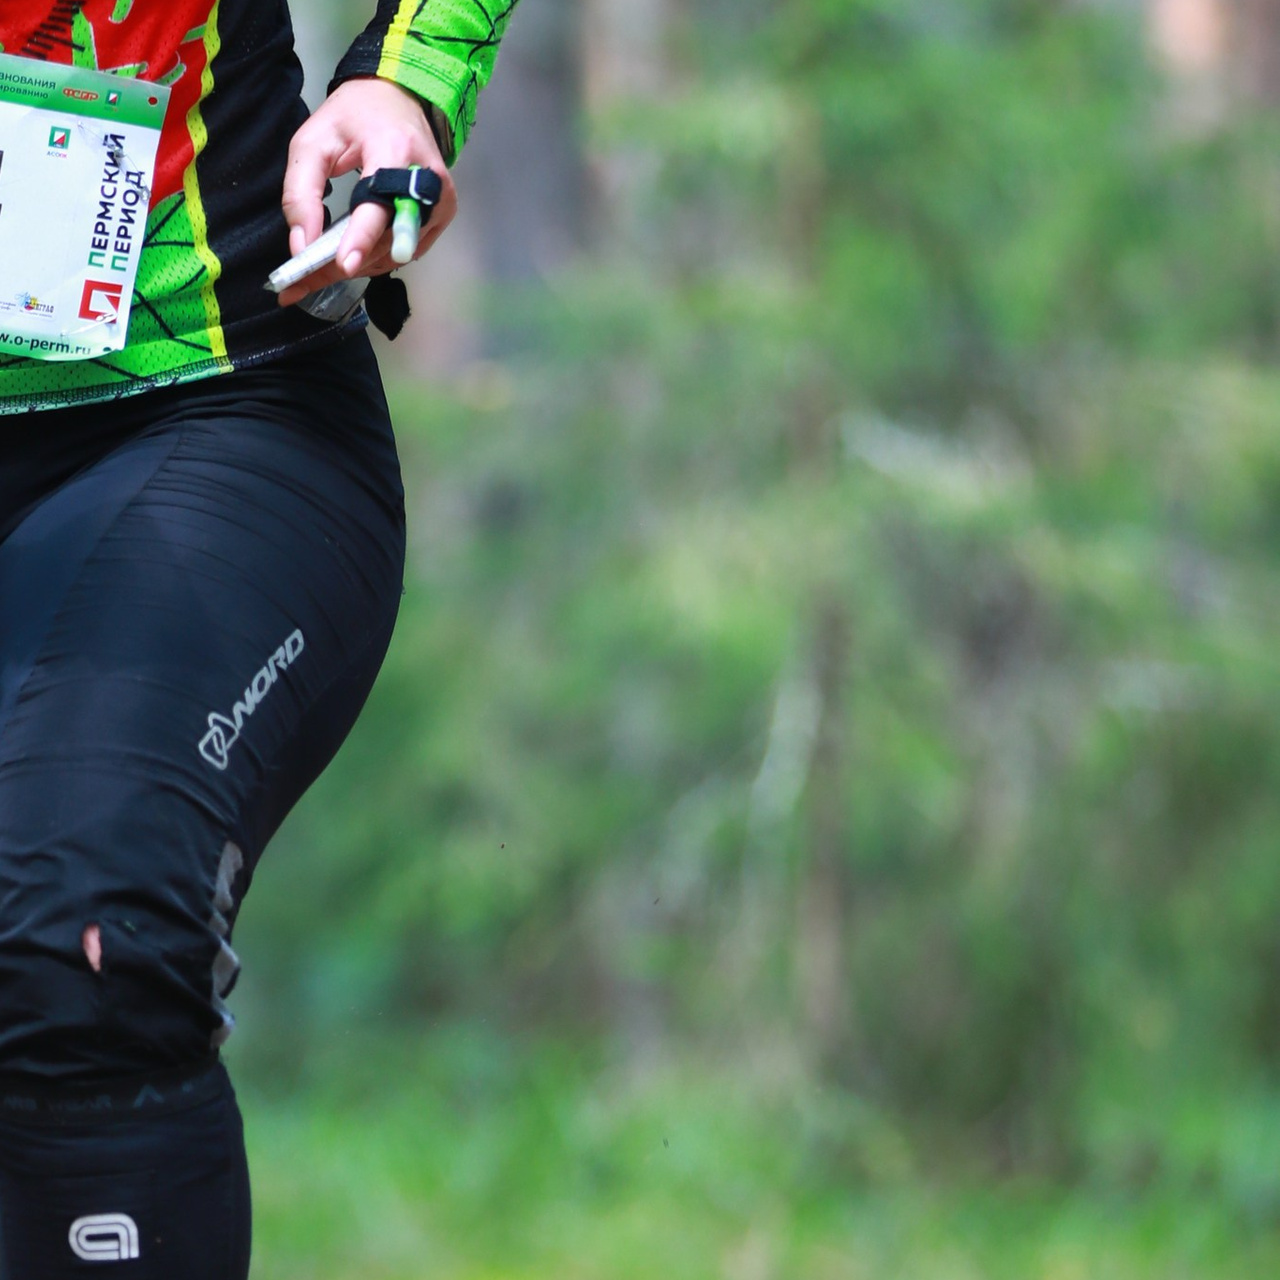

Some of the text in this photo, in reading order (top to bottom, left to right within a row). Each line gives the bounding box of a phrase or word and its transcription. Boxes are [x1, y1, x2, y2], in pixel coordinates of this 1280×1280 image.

[88, 133, 126, 268] ПЕРМСКИЙ
[110, 170, 145, 272] ПЕРИОД
[233, 628, 305, 730] NORD
